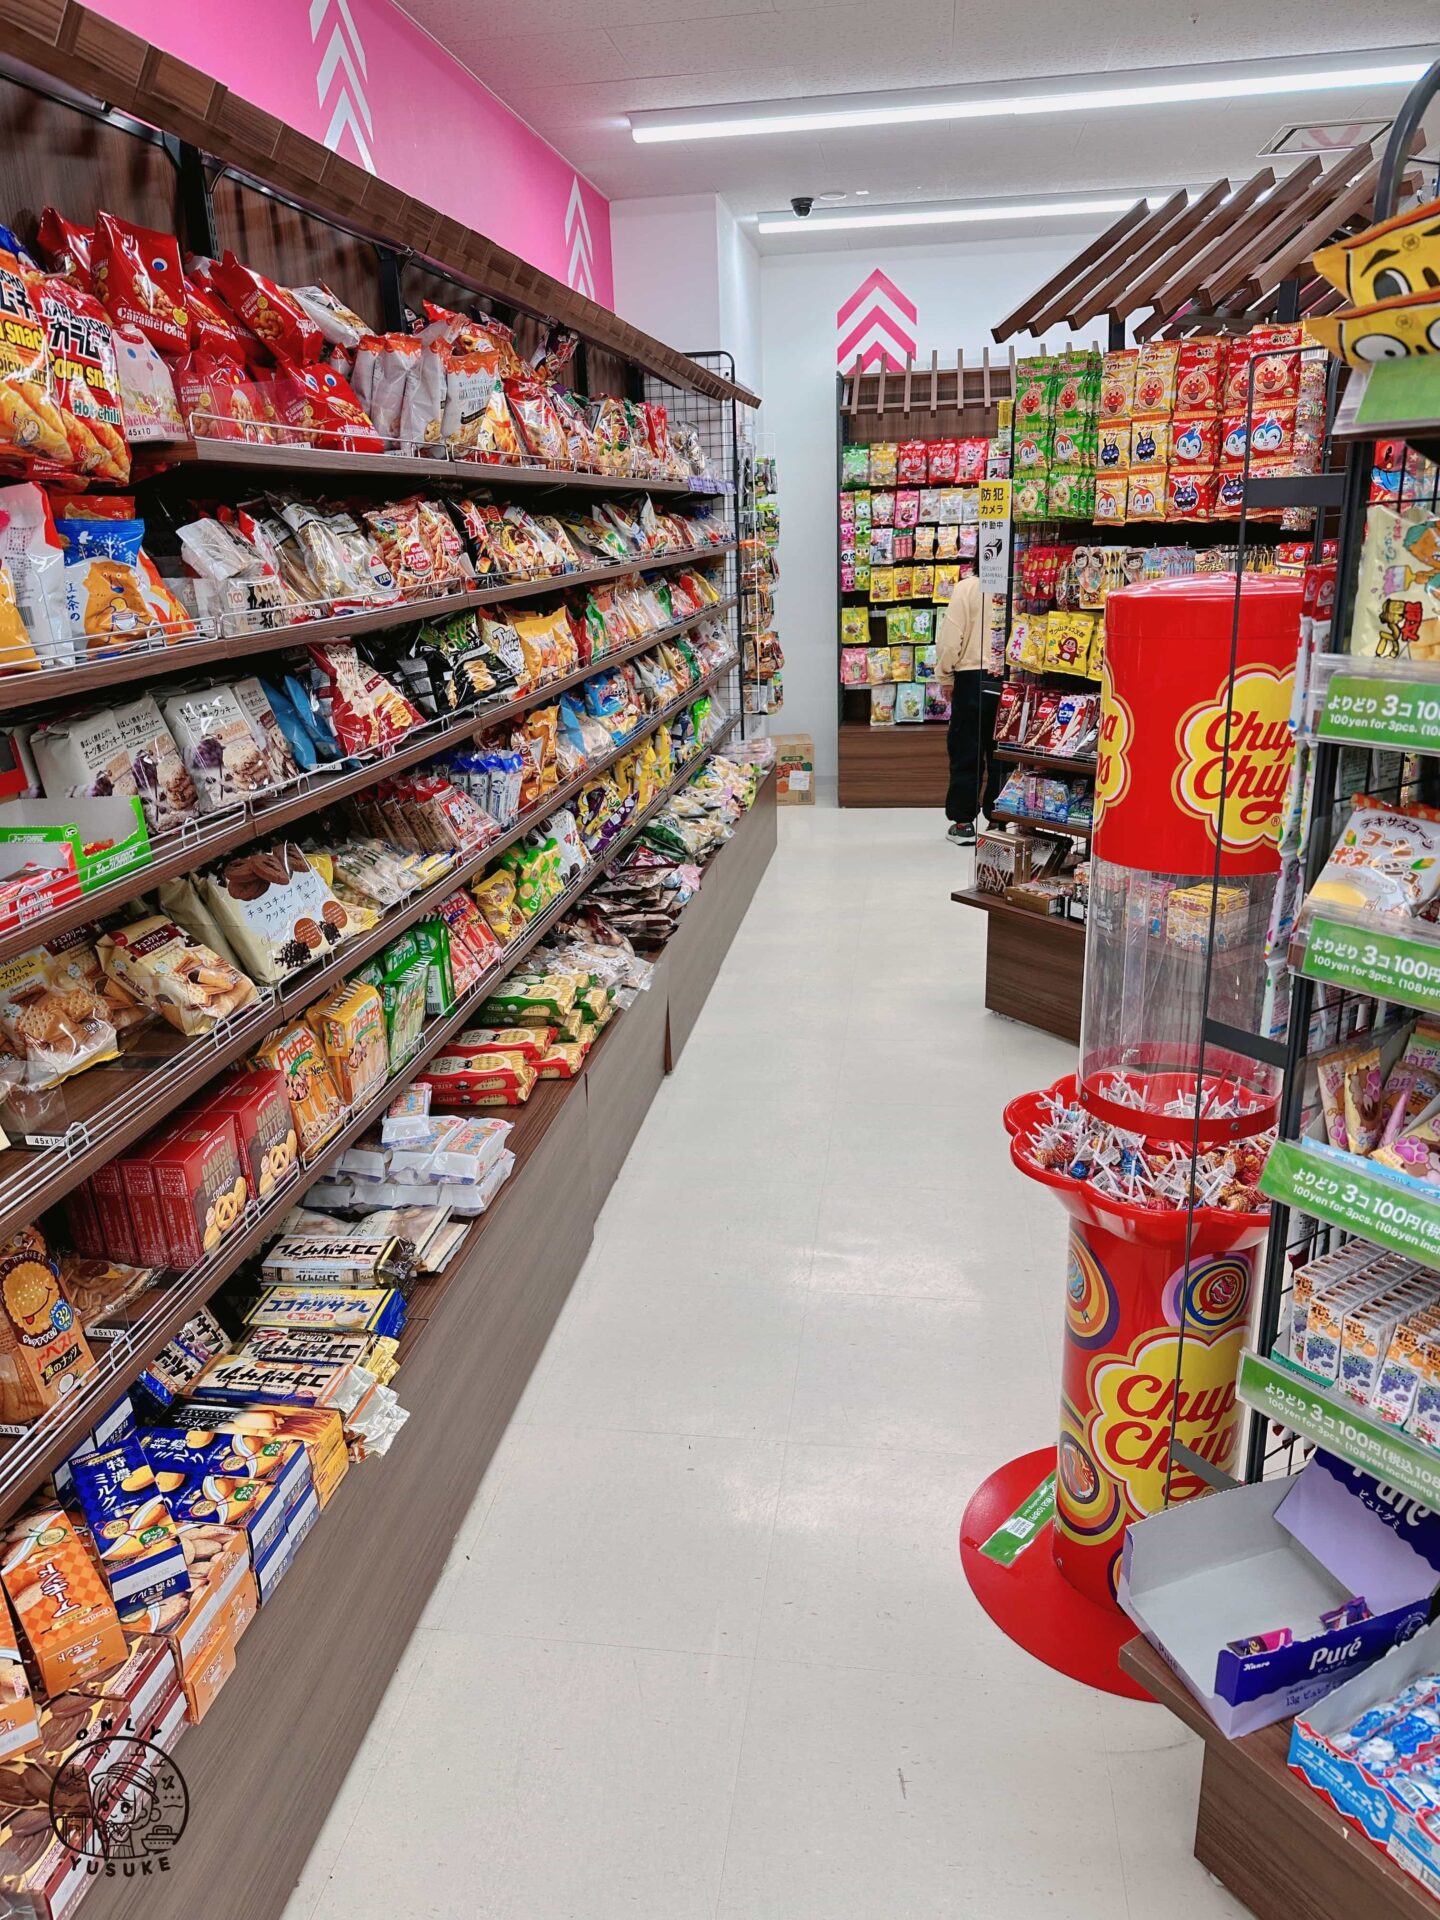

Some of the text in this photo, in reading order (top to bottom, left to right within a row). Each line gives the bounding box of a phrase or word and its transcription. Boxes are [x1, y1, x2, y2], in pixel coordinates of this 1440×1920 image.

[117, 307, 163, 331] Caramel
[97, 405, 122, 427] chili
[127, 427, 152, 437] 45x10
[980, 487, 1005, 501] 防犯
[980, 504, 1005, 515] カメラ
[980, 520, 1004, 531] 作動中
[1328, 694, 1378, 714] よりどり
[1381, 694, 1413, 718] 3コ
[1370, 718, 1388, 730] for
[1388, 720, 1417, 734] 3pcs.
[1362, 816, 1434, 850] テキサスコーン
[247, 888, 294, 919] チョコチップ
[265, 904, 293, 923] クッキー
[52, 926, 88, 948] チョコクリーム
[134, 930, 169, 951] チョコクリーム
[1311, 937, 1358, 960] よりどり
[1361, 944, 1391, 970] 3コ
[1351, 963, 1367, 978] for
[1368, 967, 1396, 986] 3pcs.
[276, 1027, 314, 1071] Pretzel
[310, 1060, 328, 1076] New!
[256, 1096, 285, 1131] DANISH
[258, 1112, 288, 1146] BUTTER
[201, 1141, 233, 1180] DANISH
[203, 1156, 236, 1198] BUTTER
[1292, 1168, 1339, 1195] よりどり
[1341, 1183, 1370, 1210] 3コ
[1328, 1200, 1344, 1214] for
[1345, 1204, 1373, 1226] 3pcs.
[13, 1252, 46, 1264] HARVEST
[275, 1243, 383, 1259] ココナッツサブレ
[55, 1306, 71, 1323] 32
[264, 1298, 372, 1314] ココナッツサブレ
[93, 1329, 119, 1337] 45x10
[247, 1342, 360, 1359] ココナッツサブレ
[213, 1364, 331, 1388] ココナッツサブレ
[1264, 1382, 1306, 1411] よりどり
[1311, 1403, 1335, 1430] 3コ
[150, 1437, 189, 1451] 特濃
[154, 1450, 205, 1464] ミルク
[1302, 1415, 1316, 1430] for
[1386, 1462, 1433, 1498] including
[106, 1456, 133, 1485] 特濃
[94, 1472, 118, 1511] ミルク
[1359, 1489, 1401, 1530] ピュレグミ
[37, 1562, 82, 1620] アーモンド
[129, 1577, 177, 1604] 特濃ミルク
[57, 1635, 103, 1663] アーモンド
[1309, 1636, 1362, 1671] Puré
